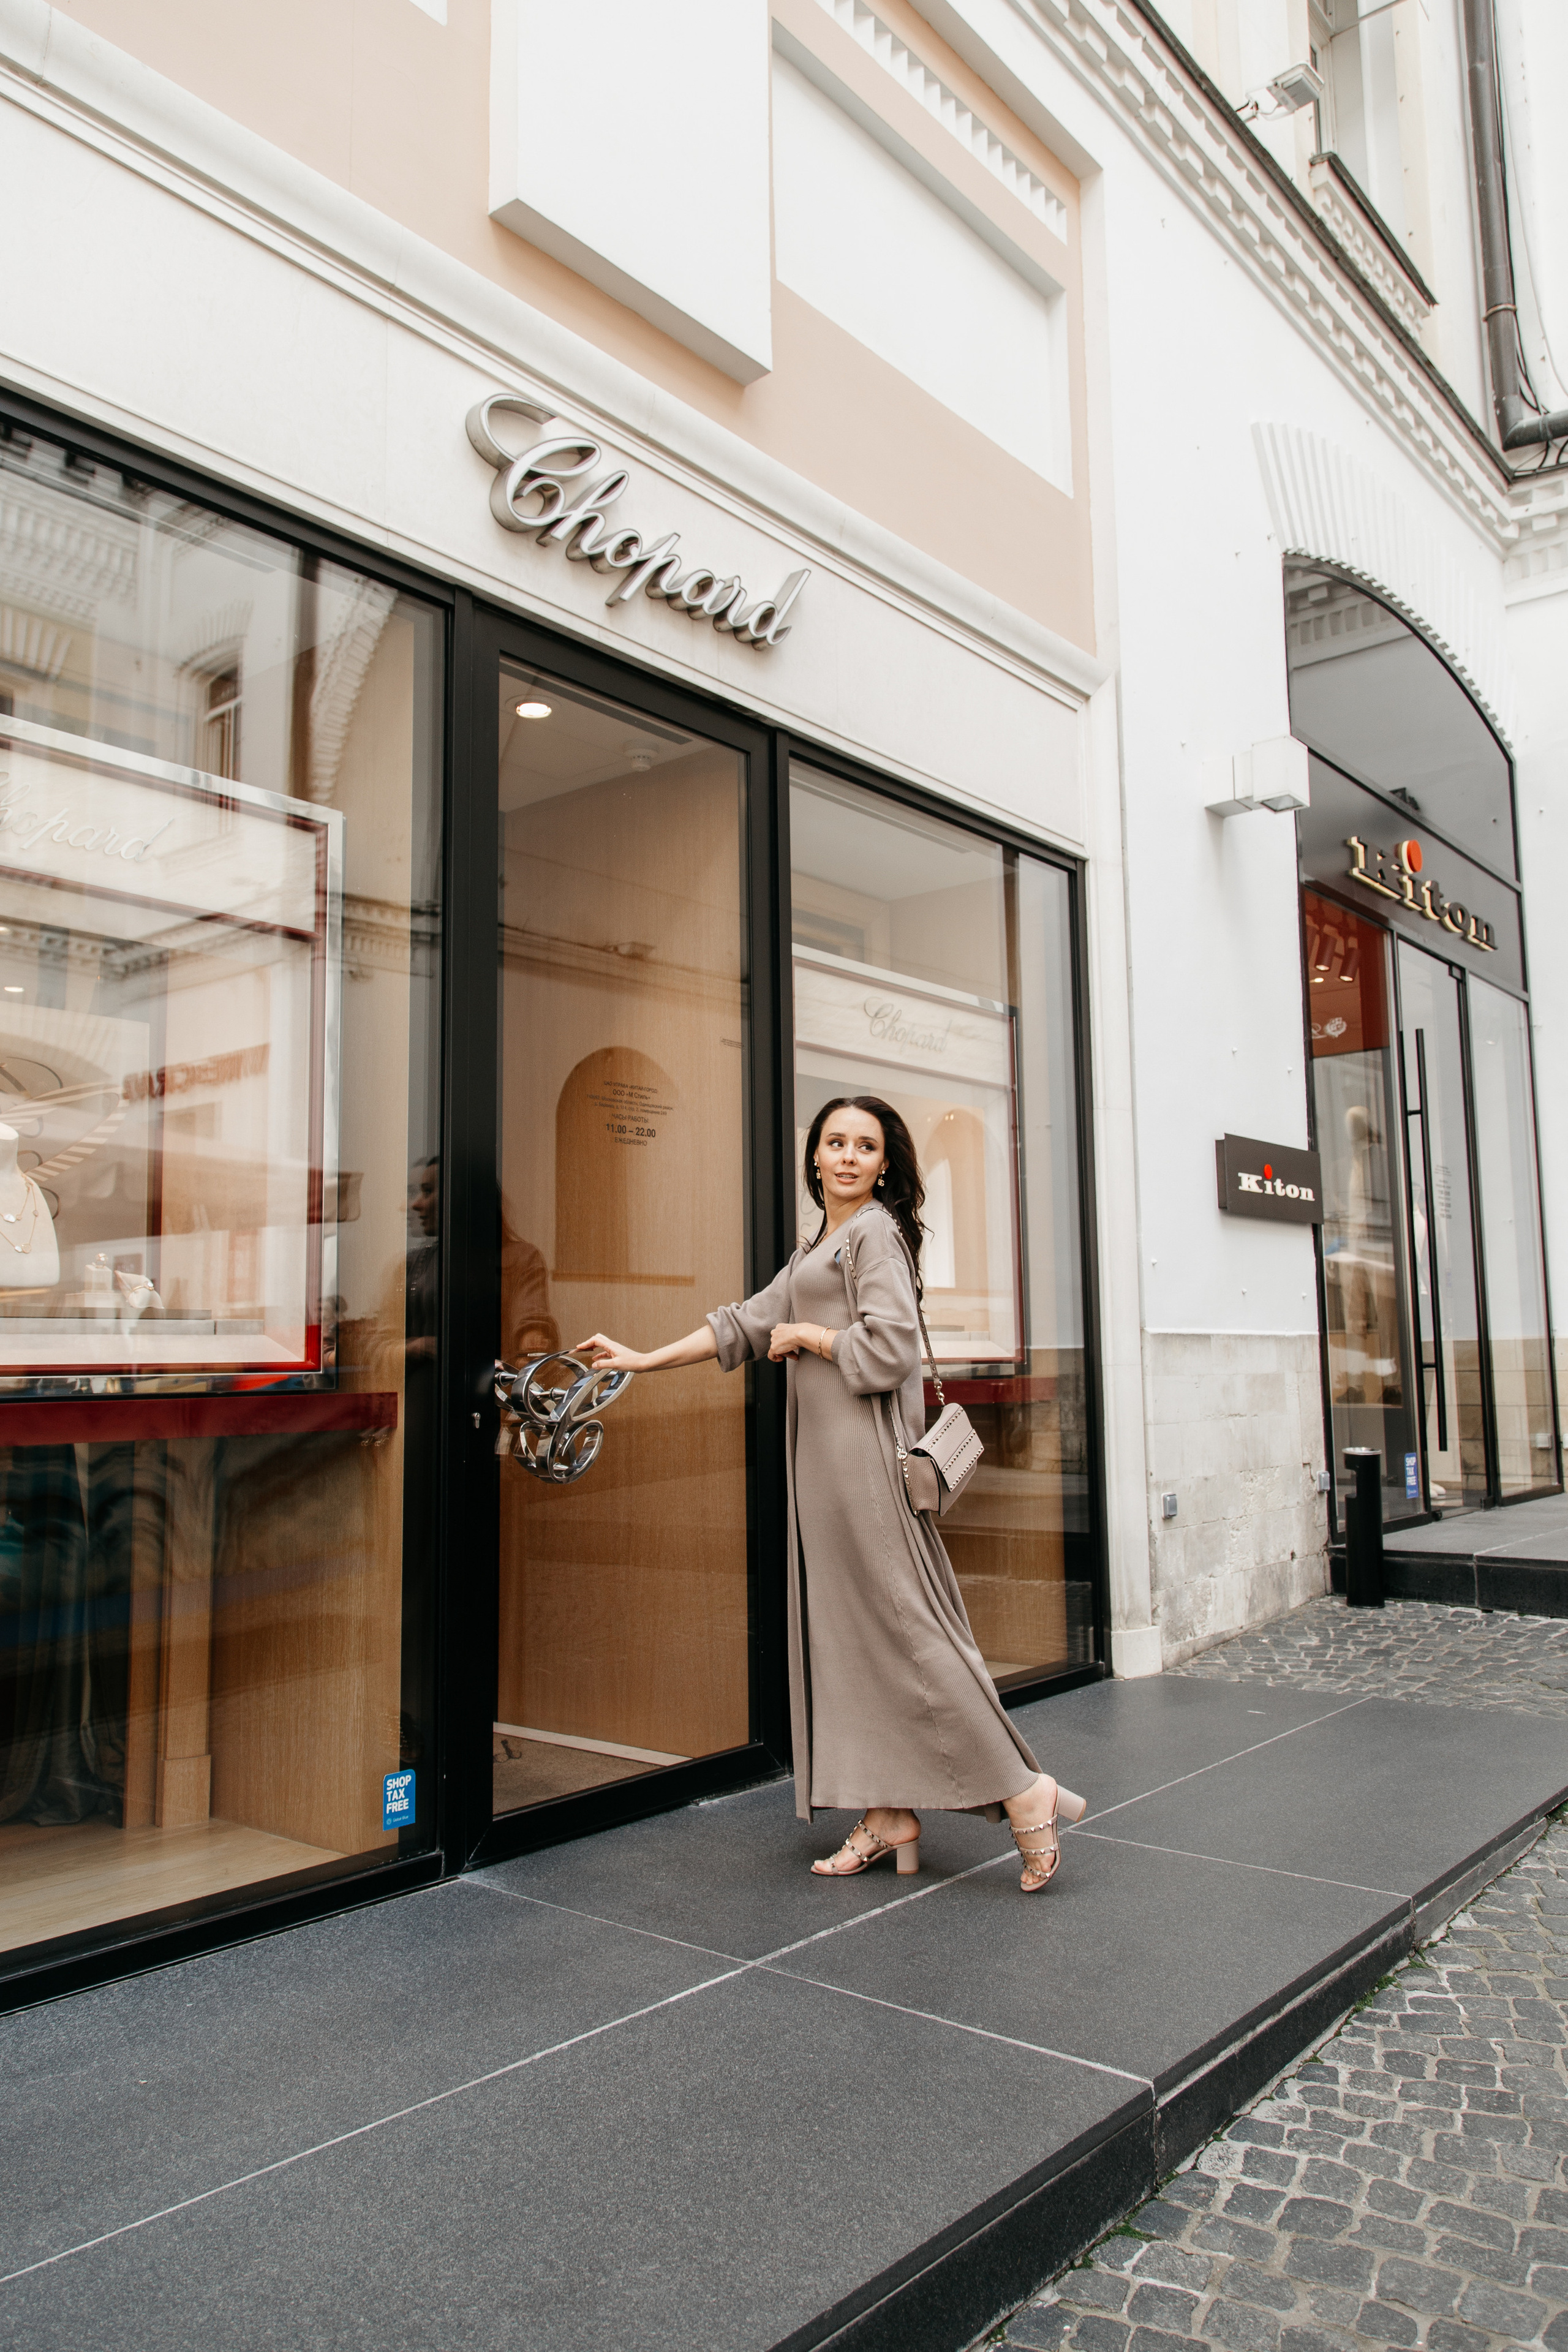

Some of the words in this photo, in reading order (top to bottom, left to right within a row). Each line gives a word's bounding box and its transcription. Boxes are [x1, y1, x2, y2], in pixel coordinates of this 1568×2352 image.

[466, 393, 812, 651] Chopard
[1348, 835, 1498, 952] Kiton
[864, 996, 952, 1054] Chopard
[606, 1123, 627, 1134] 11.00
[635, 1127, 656, 1137] 22.00
[614, 1137, 647, 1146] ЕЖЕДНЕВНО
[1237, 1164, 1315, 1201] Kiton
[386, 1774, 412, 1790] SHOP
[386, 1787, 405, 1802] TAX
[386, 1798, 409, 1814] FREE
